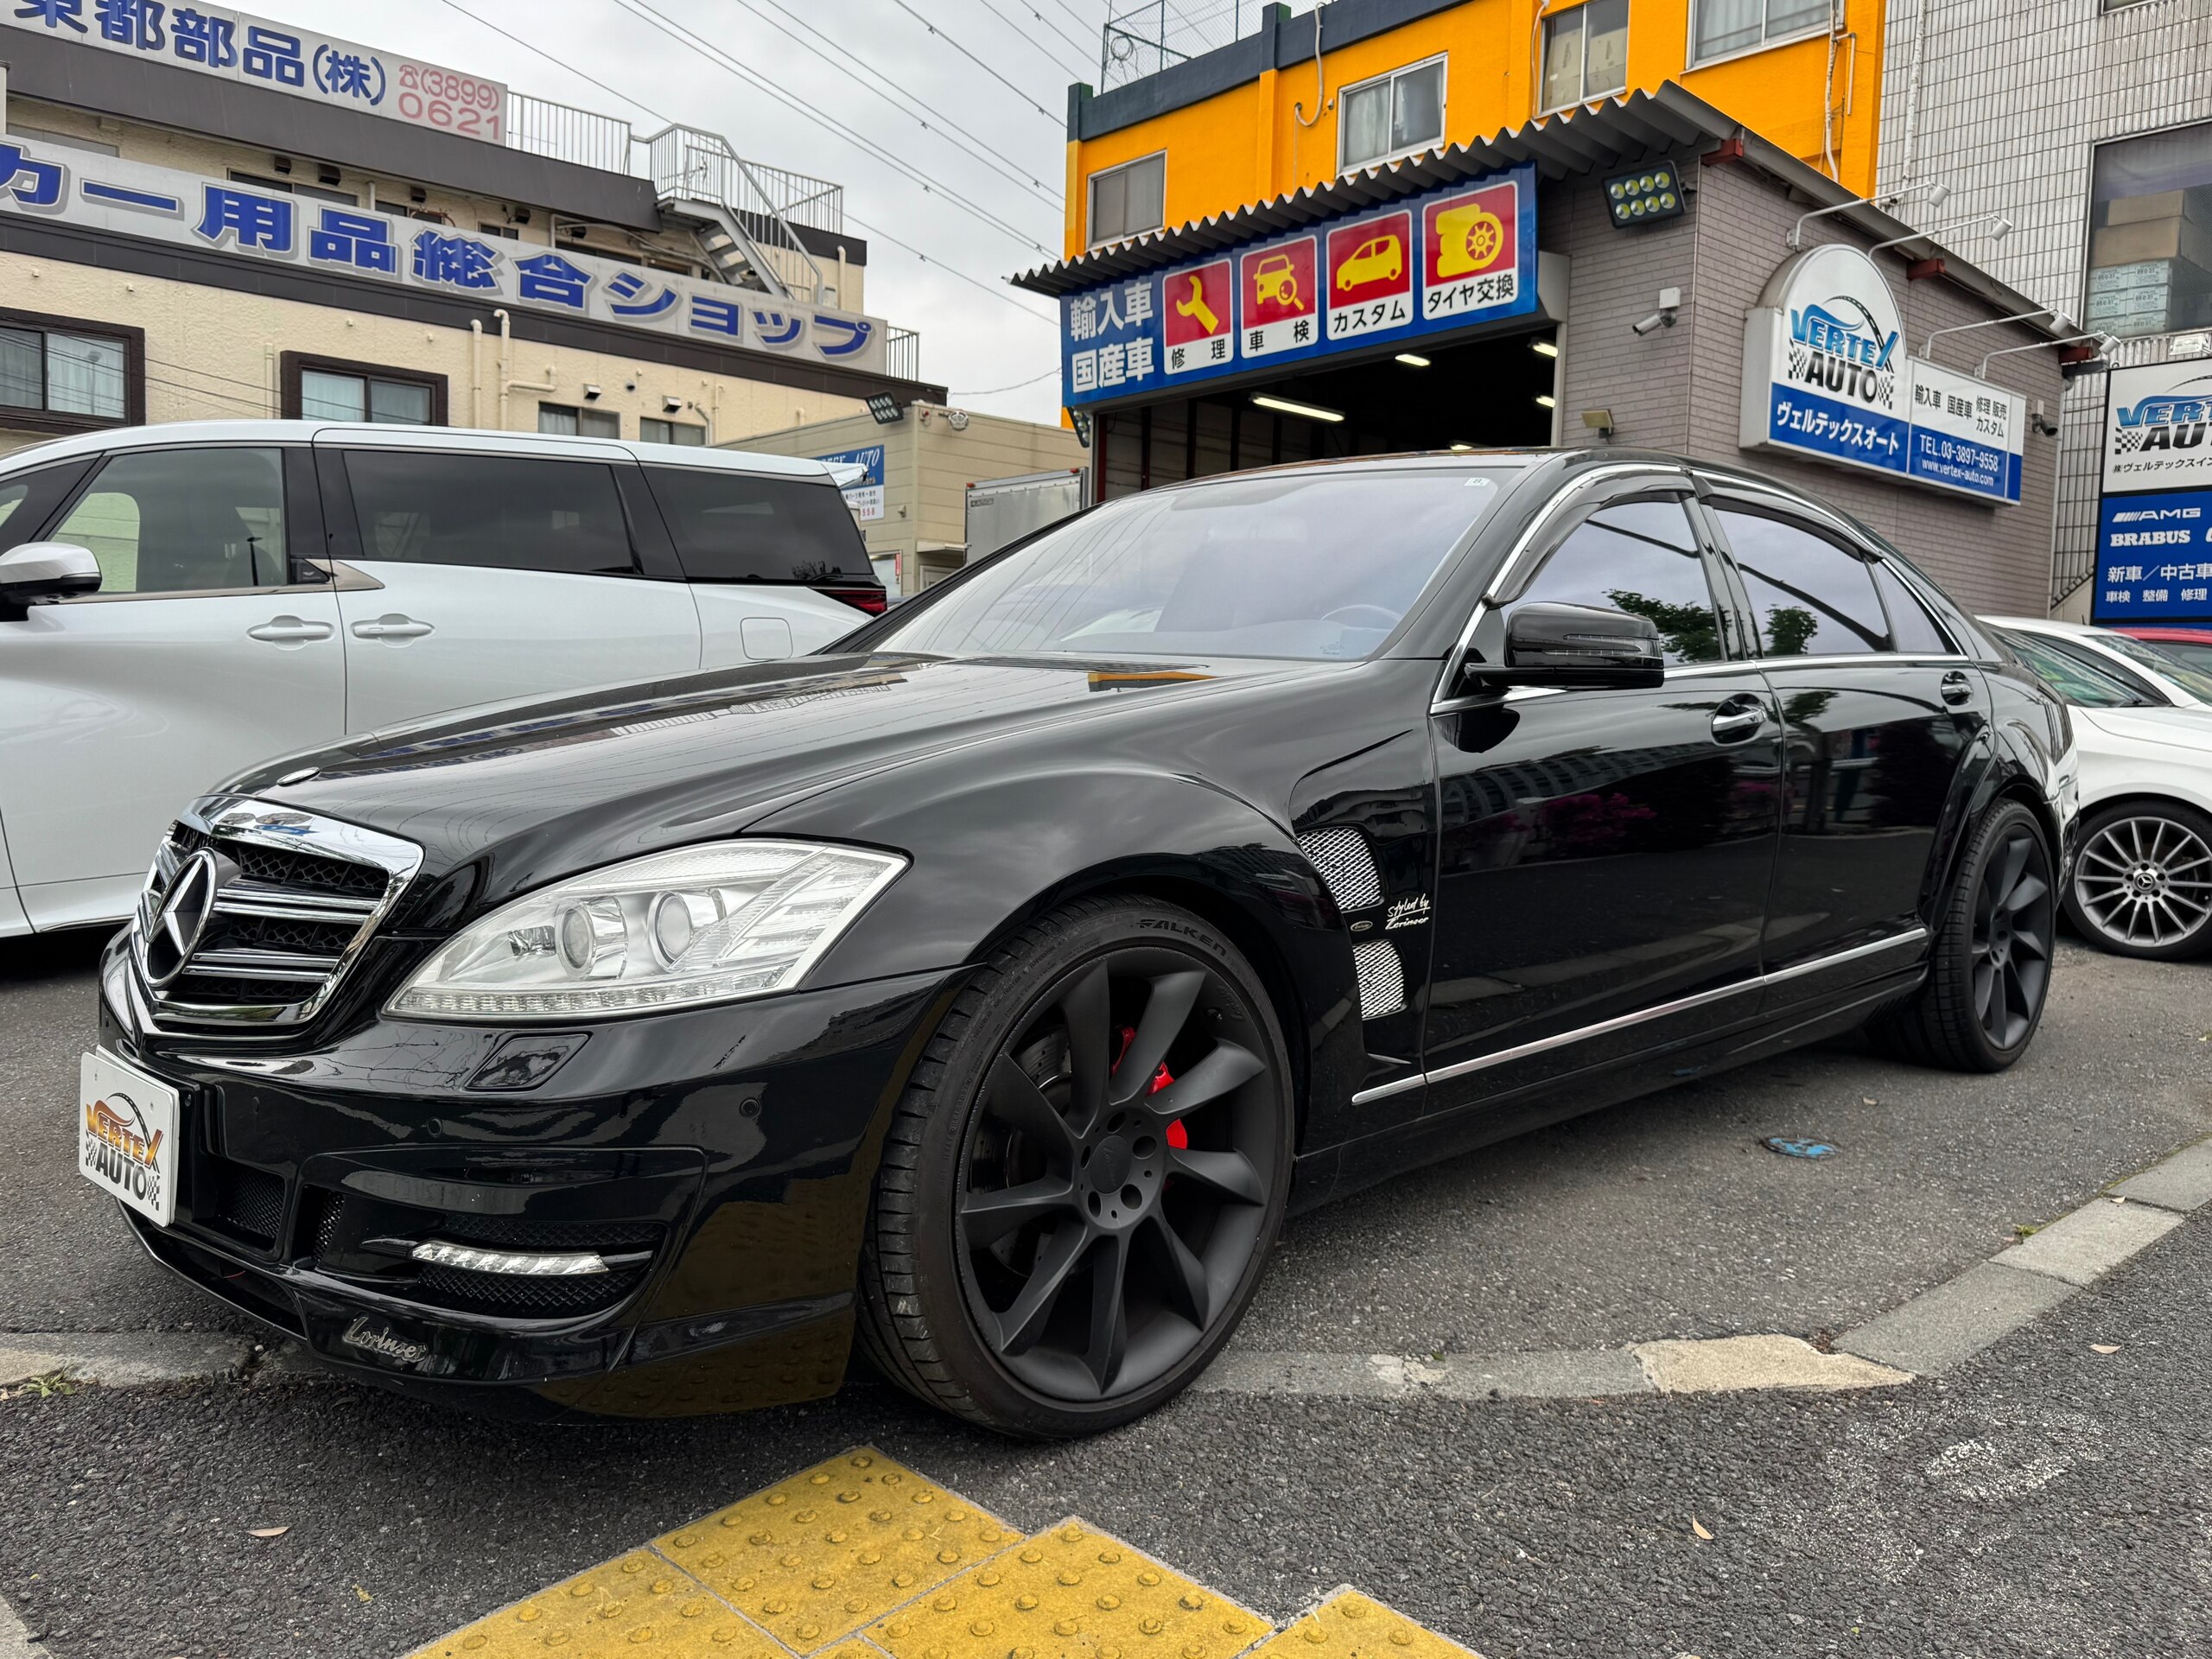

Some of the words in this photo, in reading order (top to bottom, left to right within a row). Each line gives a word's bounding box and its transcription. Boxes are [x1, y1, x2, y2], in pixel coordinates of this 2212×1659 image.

[398, 92, 499, 139] 0621
[1070, 282, 1153, 342] 輸入車
[1428, 274, 1514, 314] タイヤ交換
[1334, 301, 1406, 334] カスタム
[1790, 303, 1899, 372] VERTEX
[1071, 337, 1154, 393] 国産車
[1804, 351, 1878, 404] AUTO
[1915, 383, 1942, 410] 輸入車
[1947, 395, 1973, 420] 国産車
[2116, 395, 2212, 429] VER
[1777, 401, 1899, 455] ヴェルテックスオート
[1976, 416, 2004, 438] カスタム
[2139, 423, 2212, 452] AU
[1922, 459, 1994, 486] www.vertex-auto.com
[2110, 530, 2190, 547] BRABUS
[2106, 590, 2131, 603] 車検
[2142, 589, 2168, 602] 整備
[2181, 588, 2207, 601] 修理
[86, 1099, 164, 1168] VERTEX
[96, 1142, 146, 1201] AUTO
